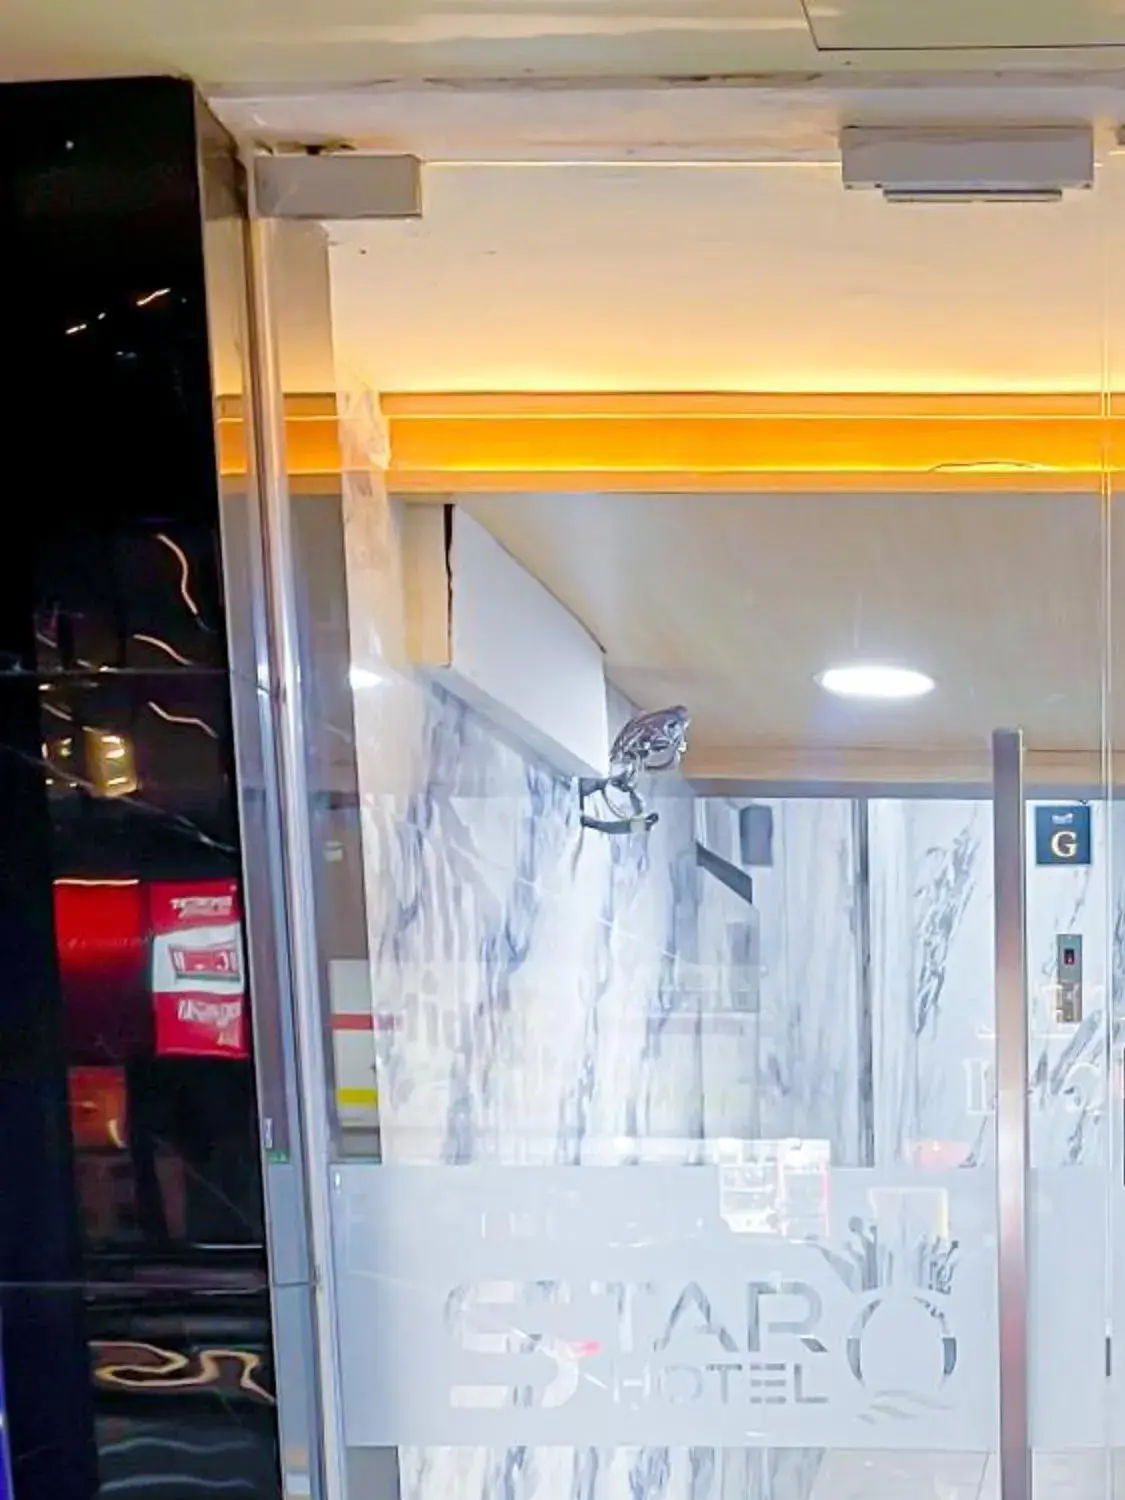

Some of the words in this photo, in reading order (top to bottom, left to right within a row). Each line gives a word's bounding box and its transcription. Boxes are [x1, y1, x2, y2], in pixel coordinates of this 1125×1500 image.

[1050, 830, 1078, 858] G
[444, 1280, 829, 1409] STAR
[611, 1362, 829, 1405] HOTEL
